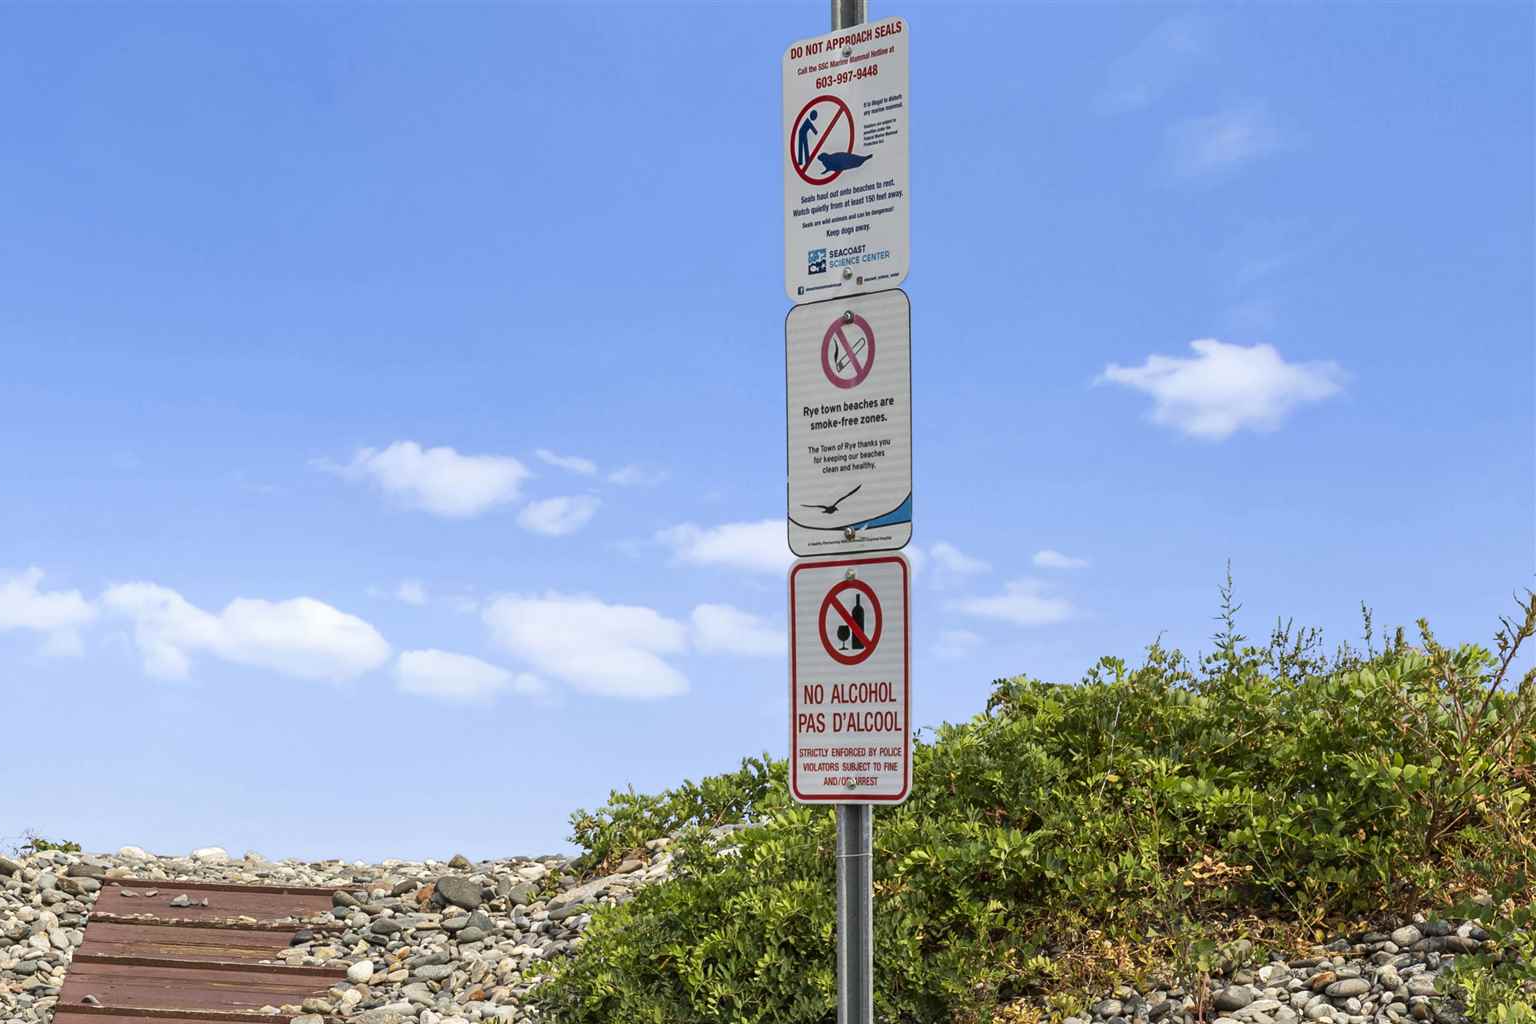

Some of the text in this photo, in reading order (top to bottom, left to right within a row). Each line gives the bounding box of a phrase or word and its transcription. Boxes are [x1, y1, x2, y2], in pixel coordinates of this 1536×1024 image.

[791, 21, 902, 59] DO NOT APPROACH SEALS
[816, 64, 878, 89] 603-997-9448
[801, 177, 895, 204] Seals haul out onto beaches to rest.
[793, 190, 903, 217] Watch quietly from at least 150 feet away.
[826, 223, 870, 237] Keep dogs away.
[829, 244, 866, 258] SEACOAST
[829, 250, 890, 268] SCIENCE CENTER
[803, 397, 895, 418] Rye town beaches are
[810, 414, 887, 430] smoke-free zones.
[821, 444, 836, 452] Town
[844, 441, 856, 451] Rye
[857, 439, 878, 448] thanks
[879, 439, 891, 447] you
[814, 456, 823, 464] for
[824, 454, 847, 463] keeping
[860, 450, 885, 459] beaches
[822, 462, 876, 474] clean and healthy.
[804, 682, 896, 704] NO ALCOHOL
[798, 711, 902, 733] PAS D'ALCOOL
[800, 747, 902, 757] STRICTLY ENFORCED BY POLICE
[803, 762, 898, 772] VIOLATORS SUBJECT TO FINE
